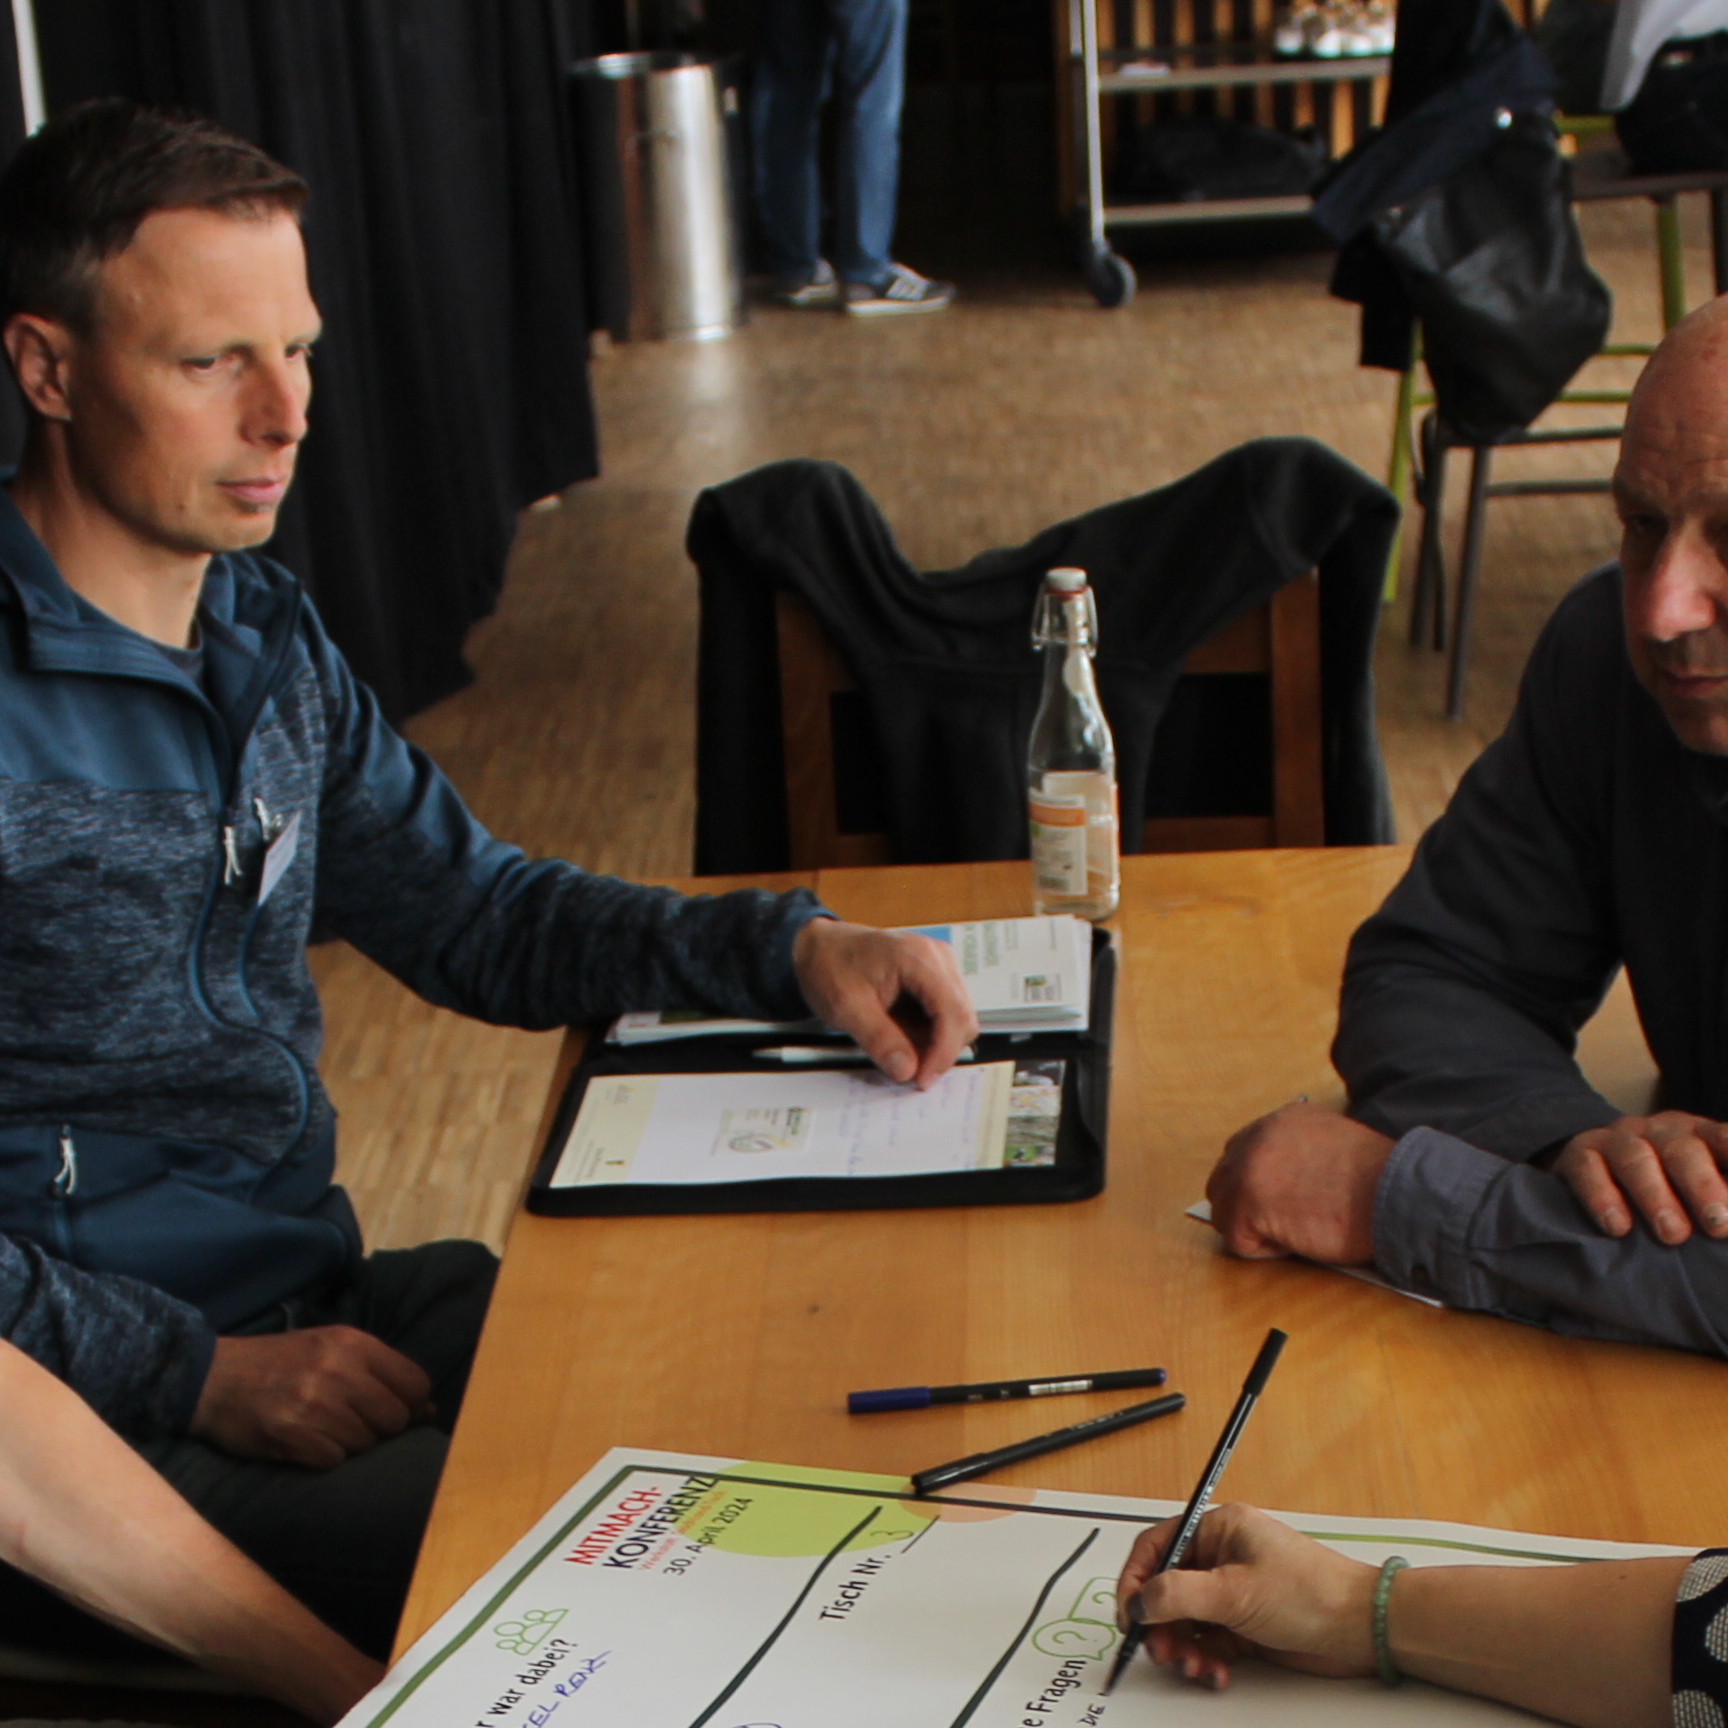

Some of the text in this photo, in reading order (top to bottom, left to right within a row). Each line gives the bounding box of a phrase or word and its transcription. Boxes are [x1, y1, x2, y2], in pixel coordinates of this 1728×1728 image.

[563, 1486, 663, 1566] MITMACH-
[602, 1475, 721, 1569] KONFERENZ
[663, 1496, 755, 1577] 30. April 2024
[819, 1553, 892, 1621] Tisch Nr.
[486, 1687, 527, 1716] war
[515, 1638, 578, 1686] dabei?
[1026, 1659, 1087, 1713] Fragen
